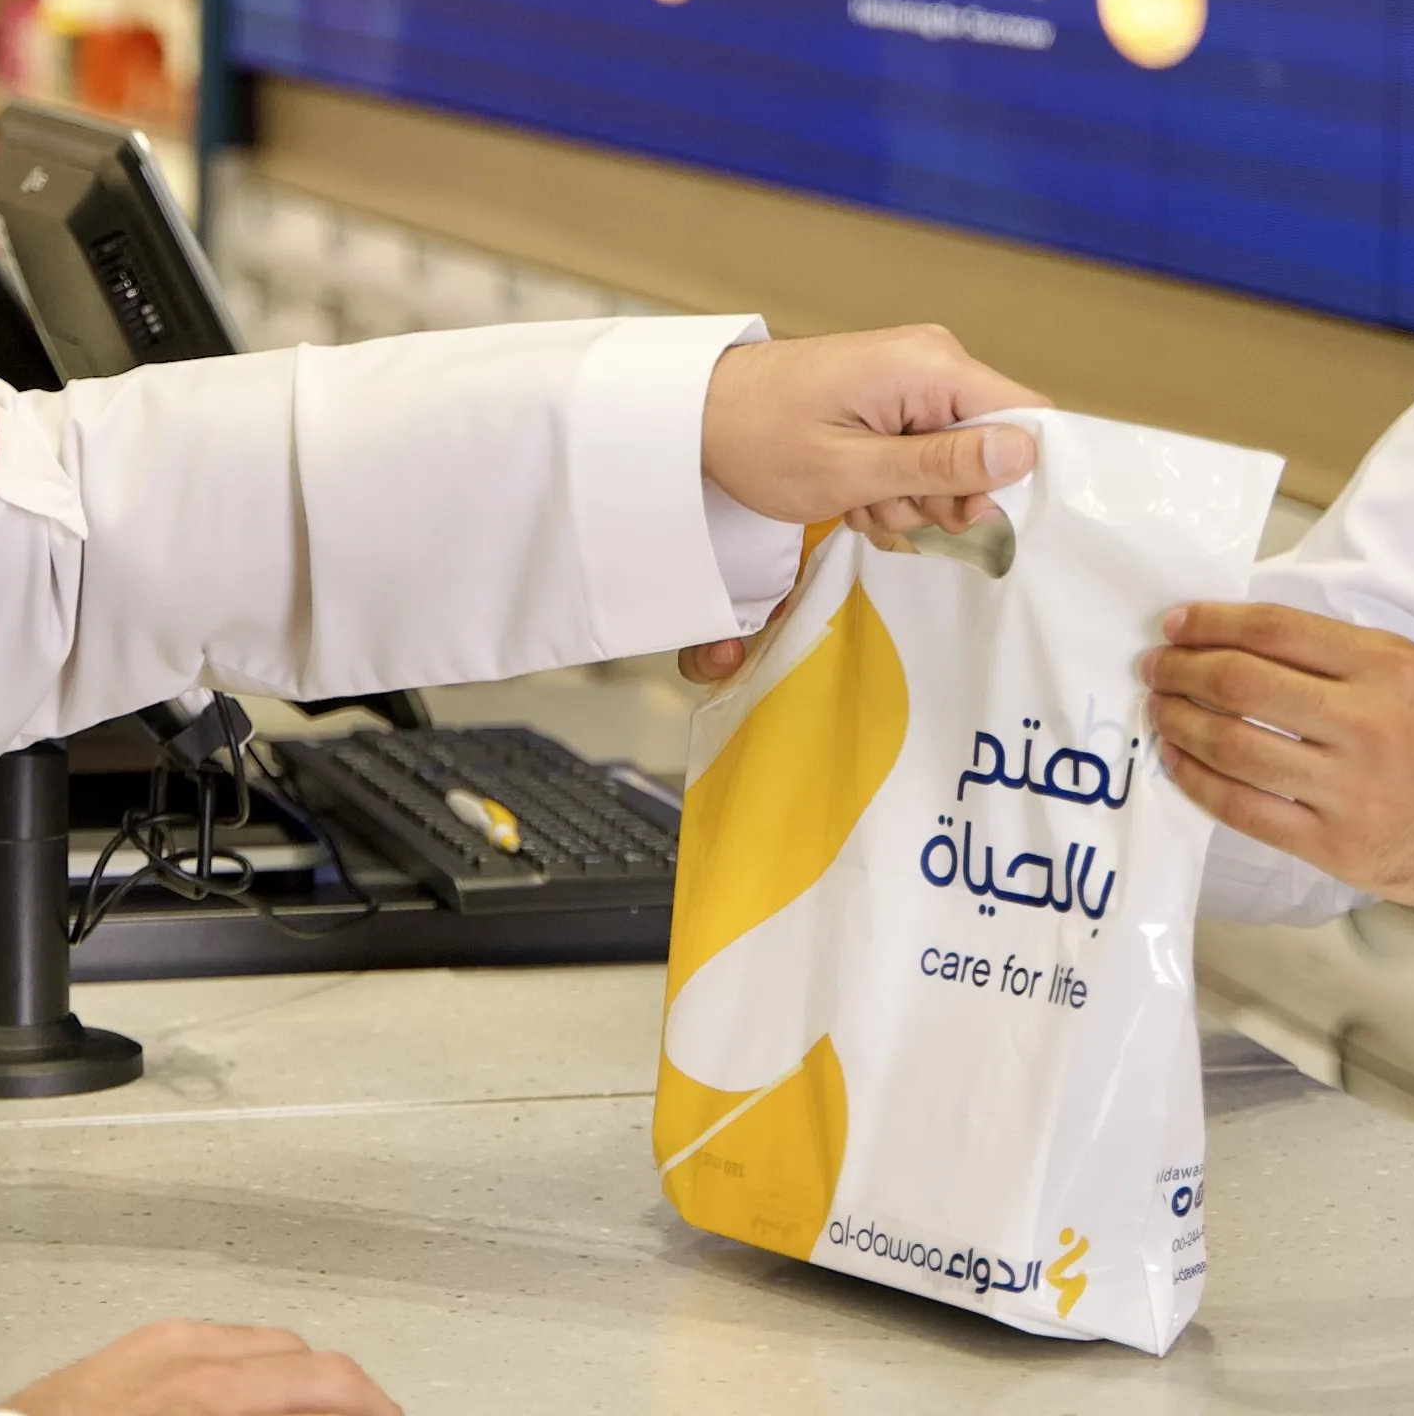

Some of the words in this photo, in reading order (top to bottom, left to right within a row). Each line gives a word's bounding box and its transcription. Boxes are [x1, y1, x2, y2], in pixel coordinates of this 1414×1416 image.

[957, 717, 1140, 810] نهتم
[920, 814, 1117, 939] بالحياة
[920, 947, 992, 988] care
[1000, 954, 1043, 999] for
[1048, 963, 1089, 1010] life
[829, 1215, 943, 1273] al-dawaa
[944, 1247, 1043, 1294] الدواء
